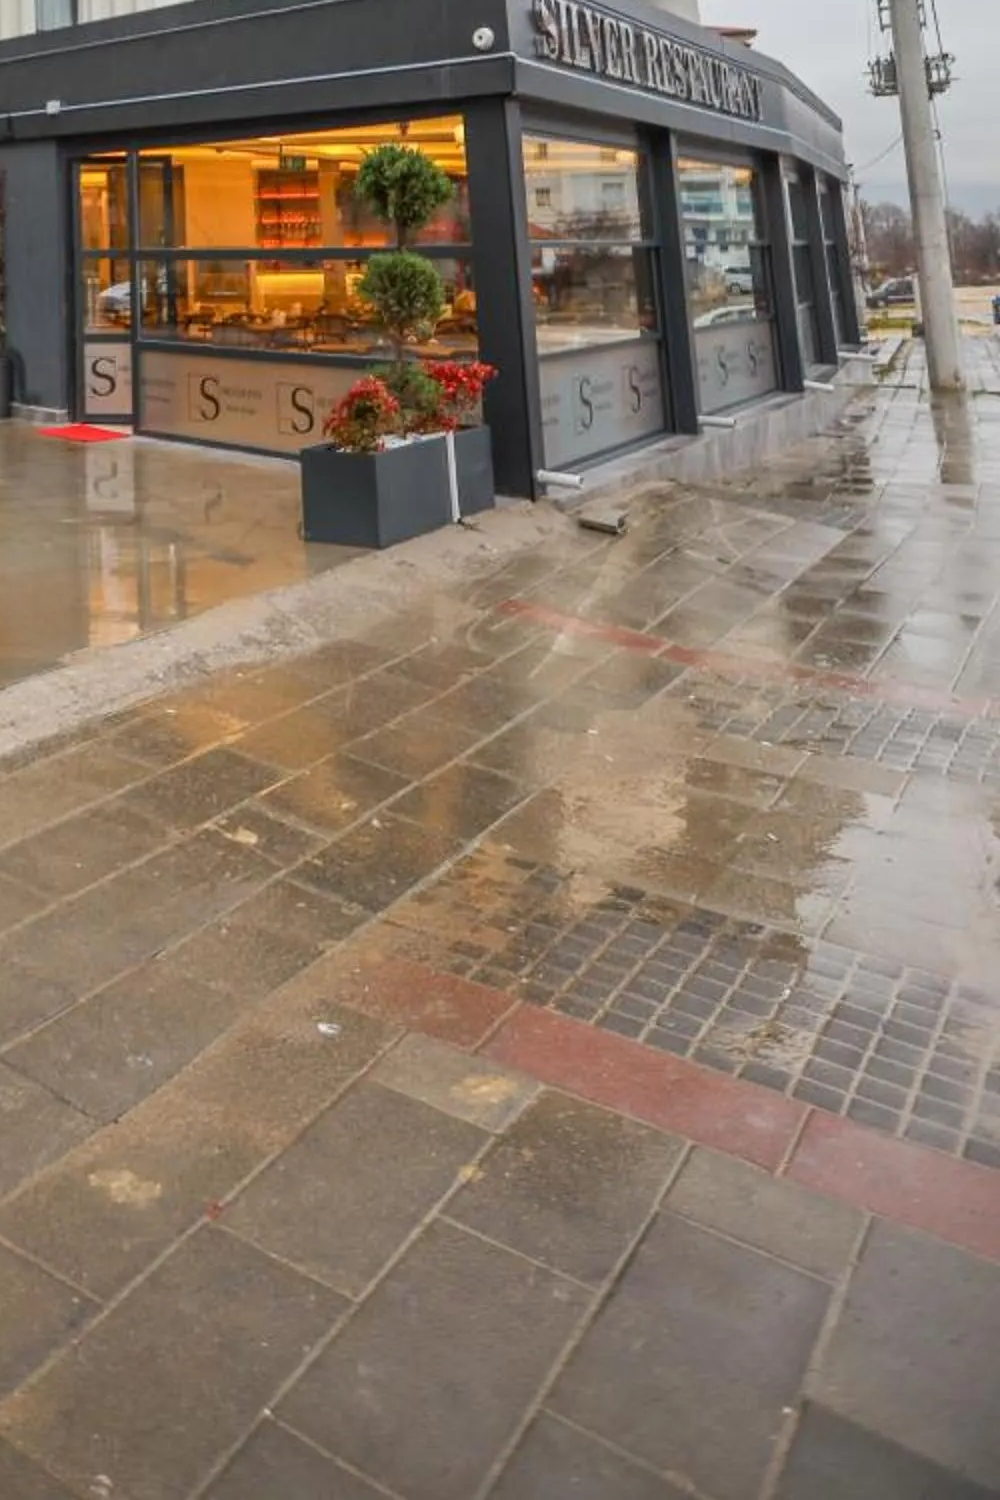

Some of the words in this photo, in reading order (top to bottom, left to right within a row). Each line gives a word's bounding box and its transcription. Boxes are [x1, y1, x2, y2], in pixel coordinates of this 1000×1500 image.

[91, 357, 117, 397] S
[200, 376, 220, 421] S
[291, 387, 315, 434] S
